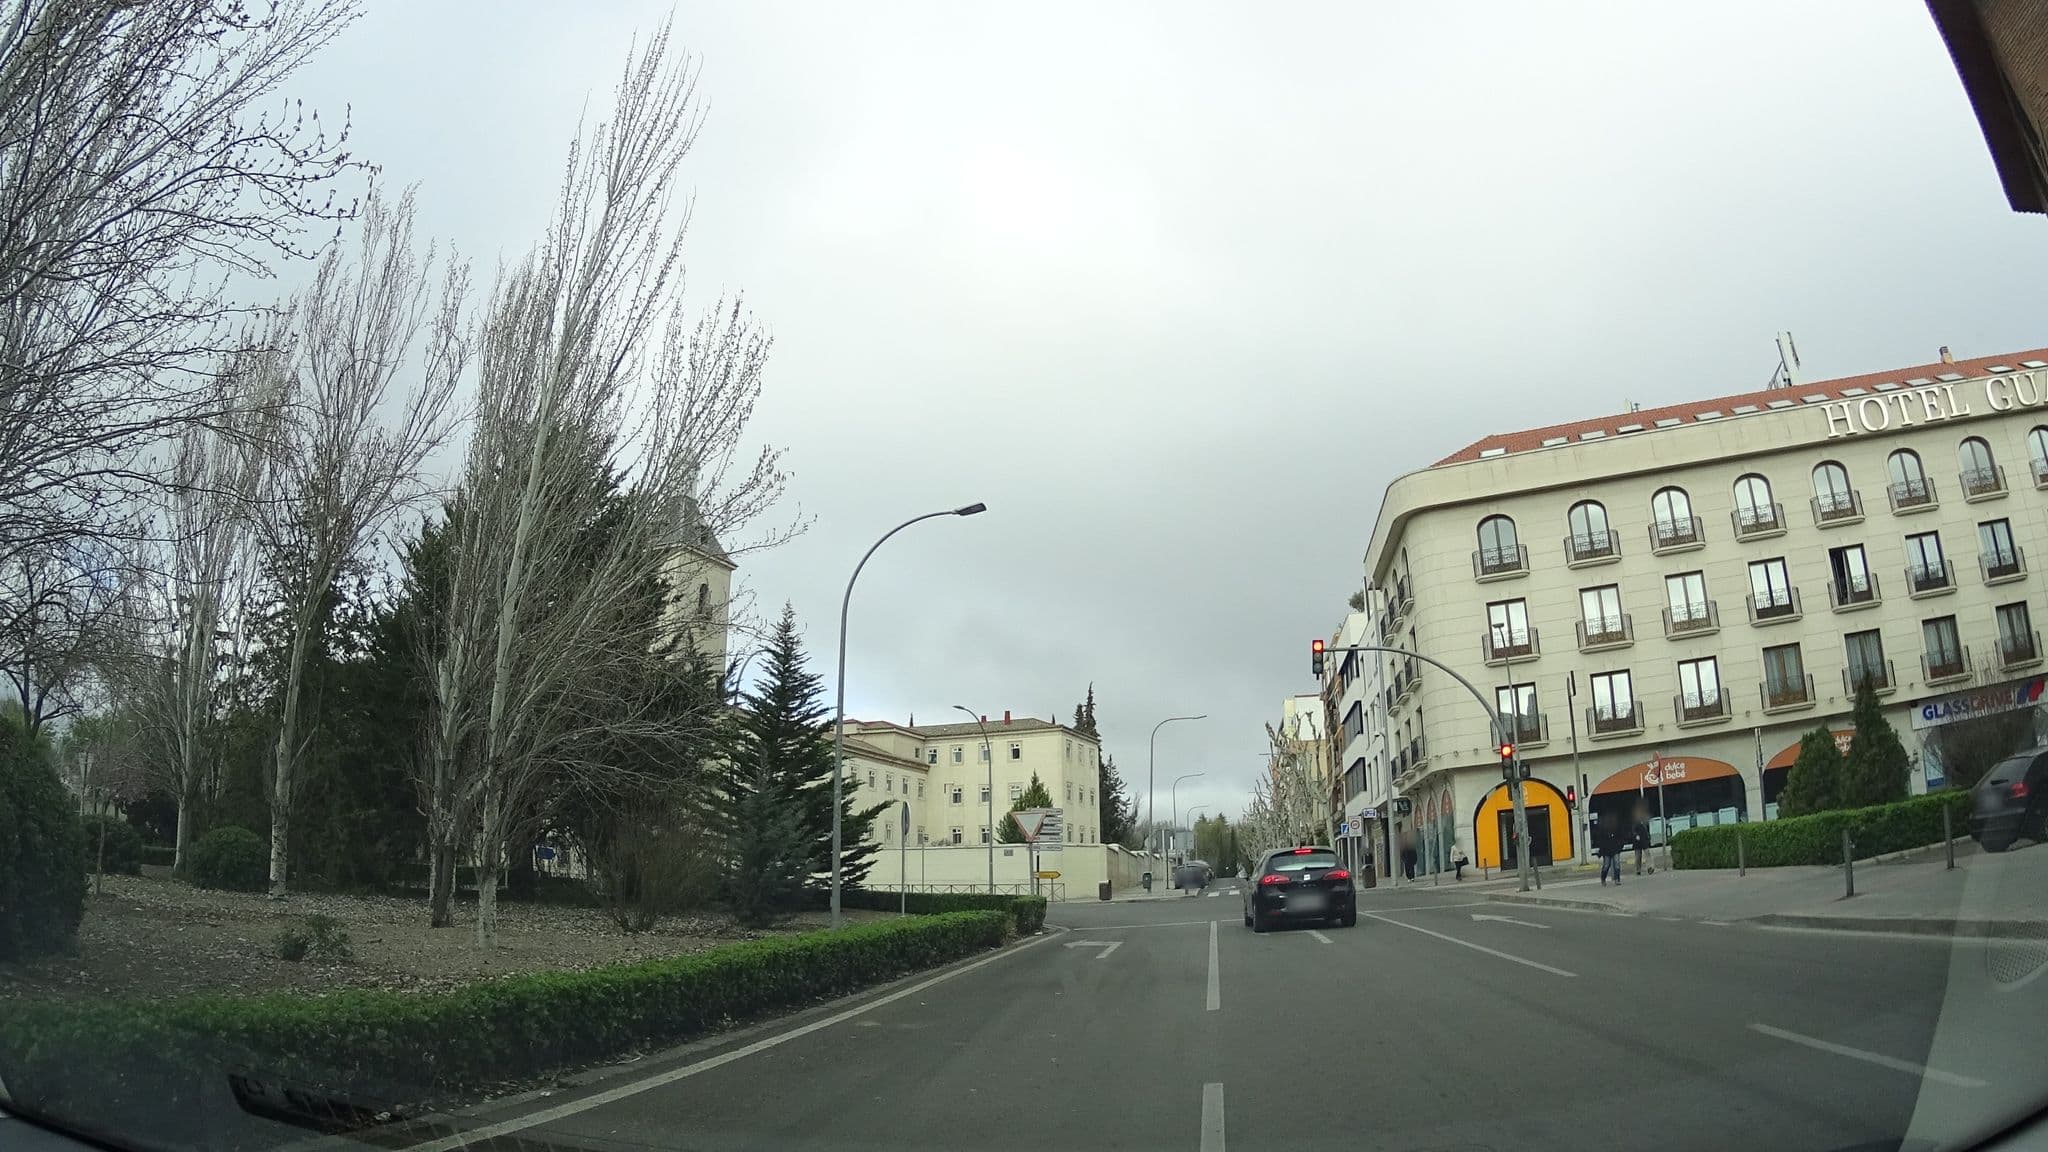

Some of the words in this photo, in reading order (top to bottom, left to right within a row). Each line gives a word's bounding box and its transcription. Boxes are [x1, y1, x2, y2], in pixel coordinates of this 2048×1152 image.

[1821, 384, 1970, 438] HOTEL
[1985, 369, 2048, 411] GU
[1664, 761, 1686, 771] dulce
